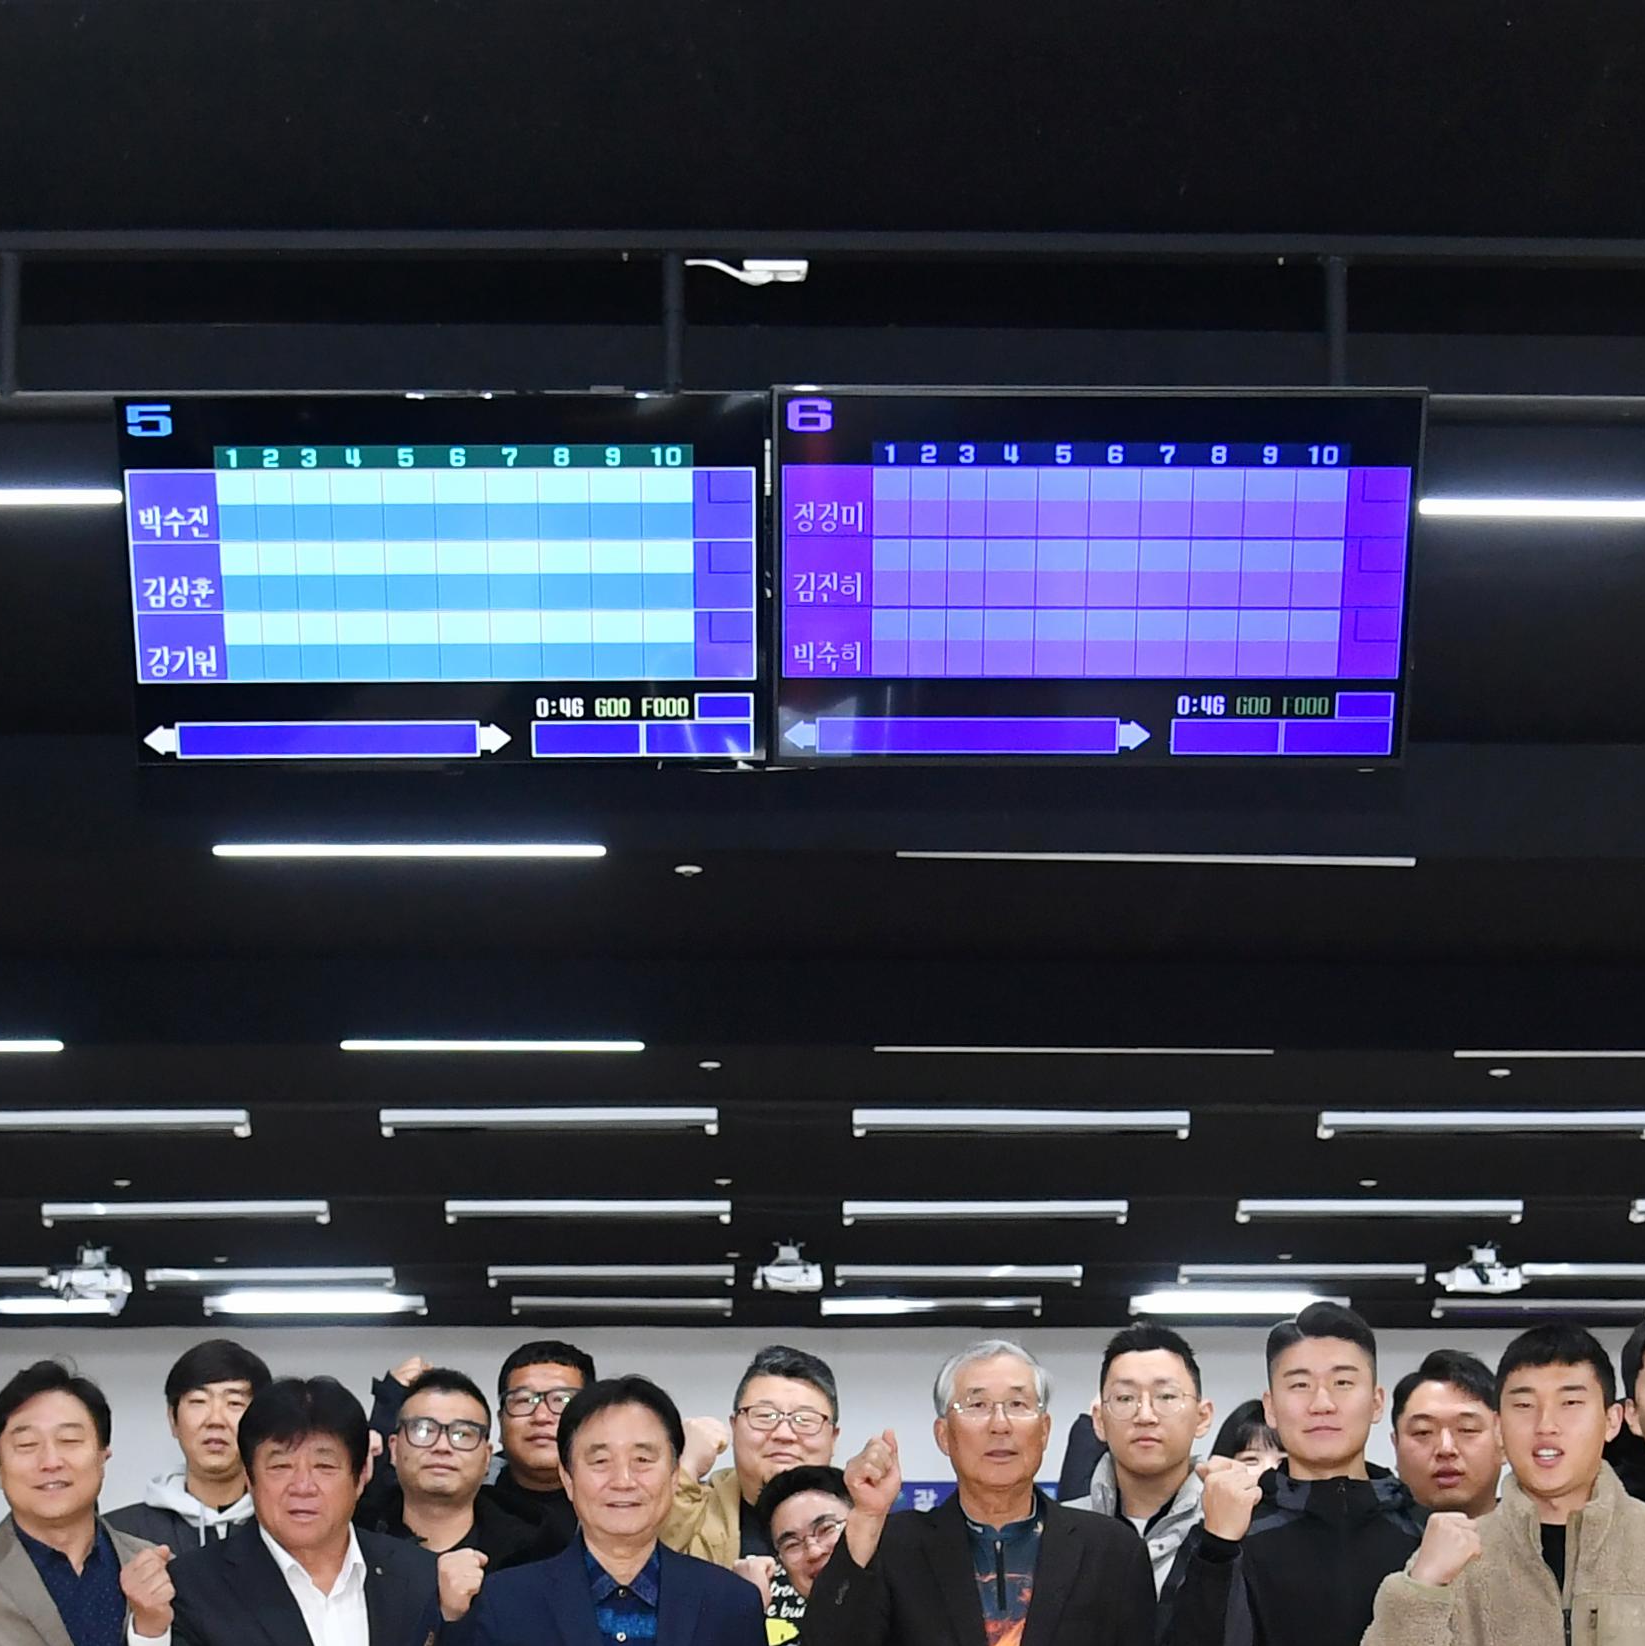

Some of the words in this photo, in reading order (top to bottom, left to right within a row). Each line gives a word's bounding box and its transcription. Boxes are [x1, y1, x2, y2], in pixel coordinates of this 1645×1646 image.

[126, 404, 172, 436] 5
[787, 398, 833, 432] 6
[227, 449, 237, 467] 1
[263, 449, 278, 467] 2
[301, 449, 316, 467] 3
[346, 448, 361, 467] 4
[398, 448, 413, 466] 5
[450, 448, 465, 466] 6
[502, 448, 517, 466] 7
[554, 448, 569, 466] 8
[606, 447, 620, 466] 9
[652, 447, 681, 465] 10
[885, 445, 894, 463] 1
[922, 445, 936, 463] 2
[960, 445, 974, 463] 3
[1005, 445, 1018, 463] 4
[1056, 445, 1071, 463] 5
[1108, 446, 1123, 463] 6
[1160, 446, 1175, 464] 7
[1212, 446, 1226, 464] 8
[1264, 446, 1277, 464] 9
[1310, 447, 1338, 464] 10
[139, 506, 208, 537] 박수진
[794, 502, 862, 532] 정경미
[143, 577, 214, 608] 김상훈
[148, 646, 216, 677] 강기원
[536, 698, 583, 717] 0:46
[1178, 696, 1225, 715] 0:46
